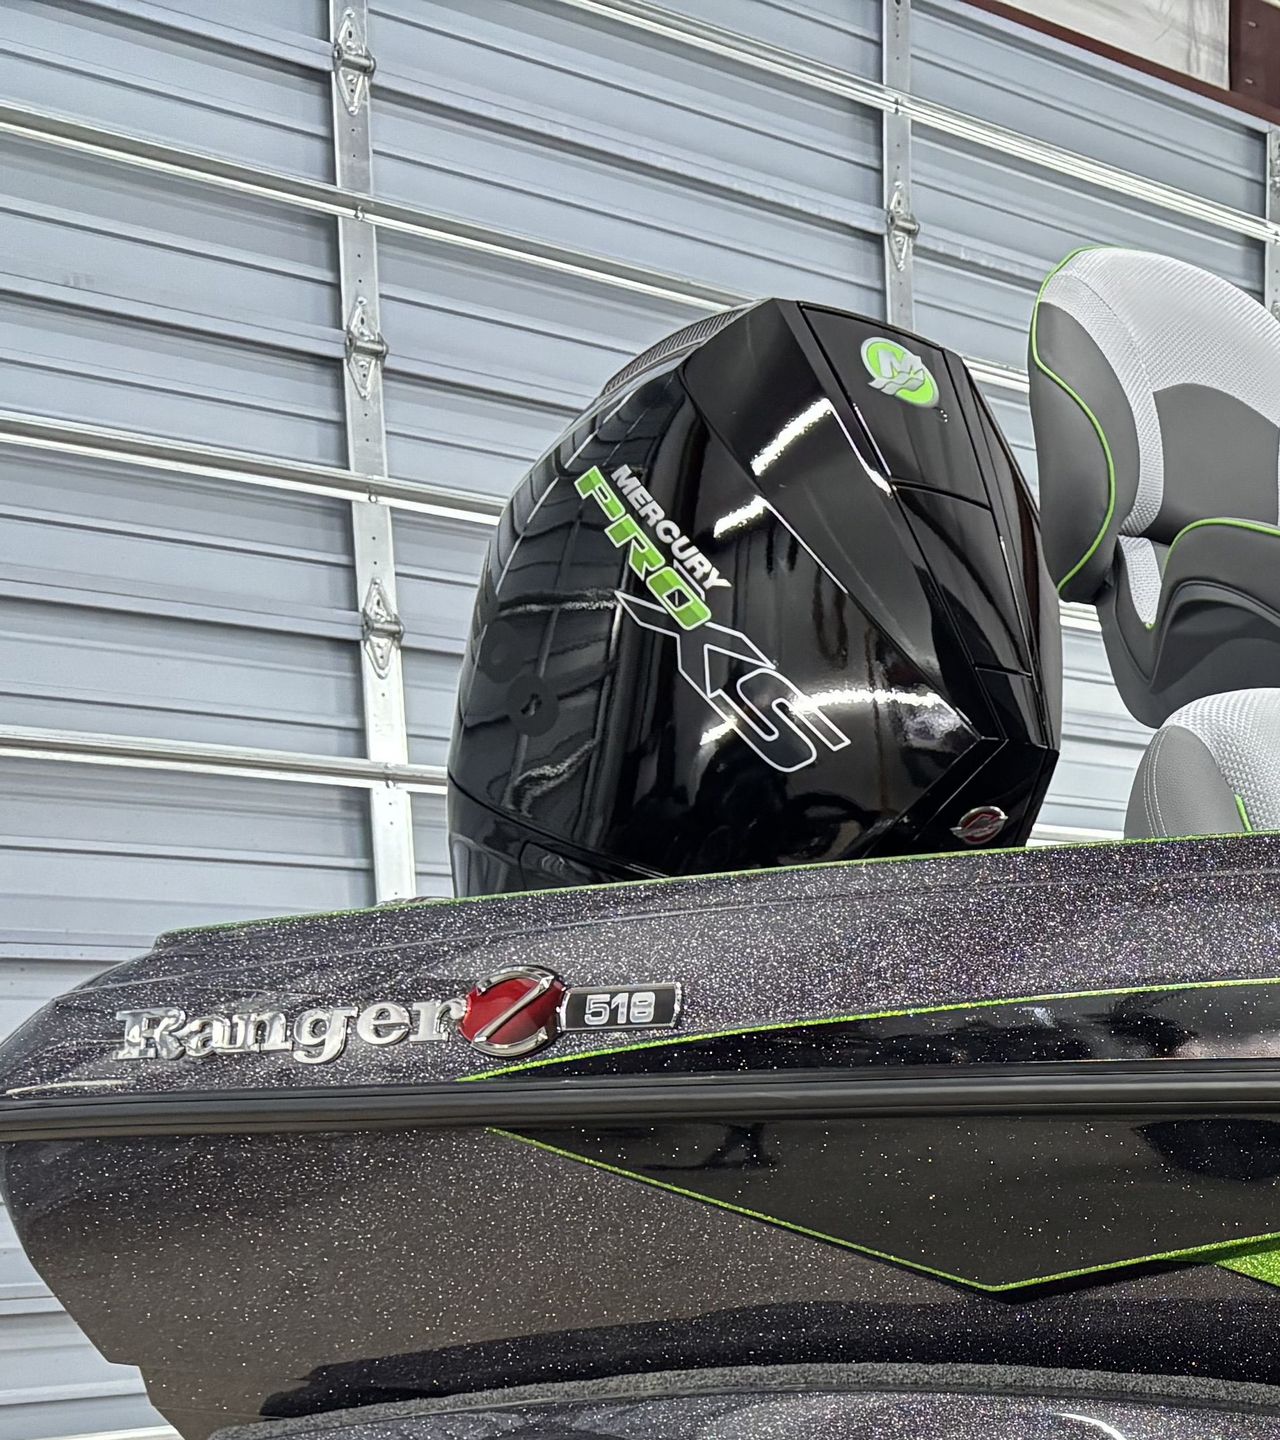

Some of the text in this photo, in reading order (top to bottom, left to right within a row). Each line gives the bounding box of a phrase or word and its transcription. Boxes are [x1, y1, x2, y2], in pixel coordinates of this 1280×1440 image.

[574, 465, 712, 631] PRO
[611, 464, 732, 590] MERCURY
[614, 559, 851, 772] XS
[112, 998, 467, 1064] Ranger
[584, 990, 656, 1026] 518
